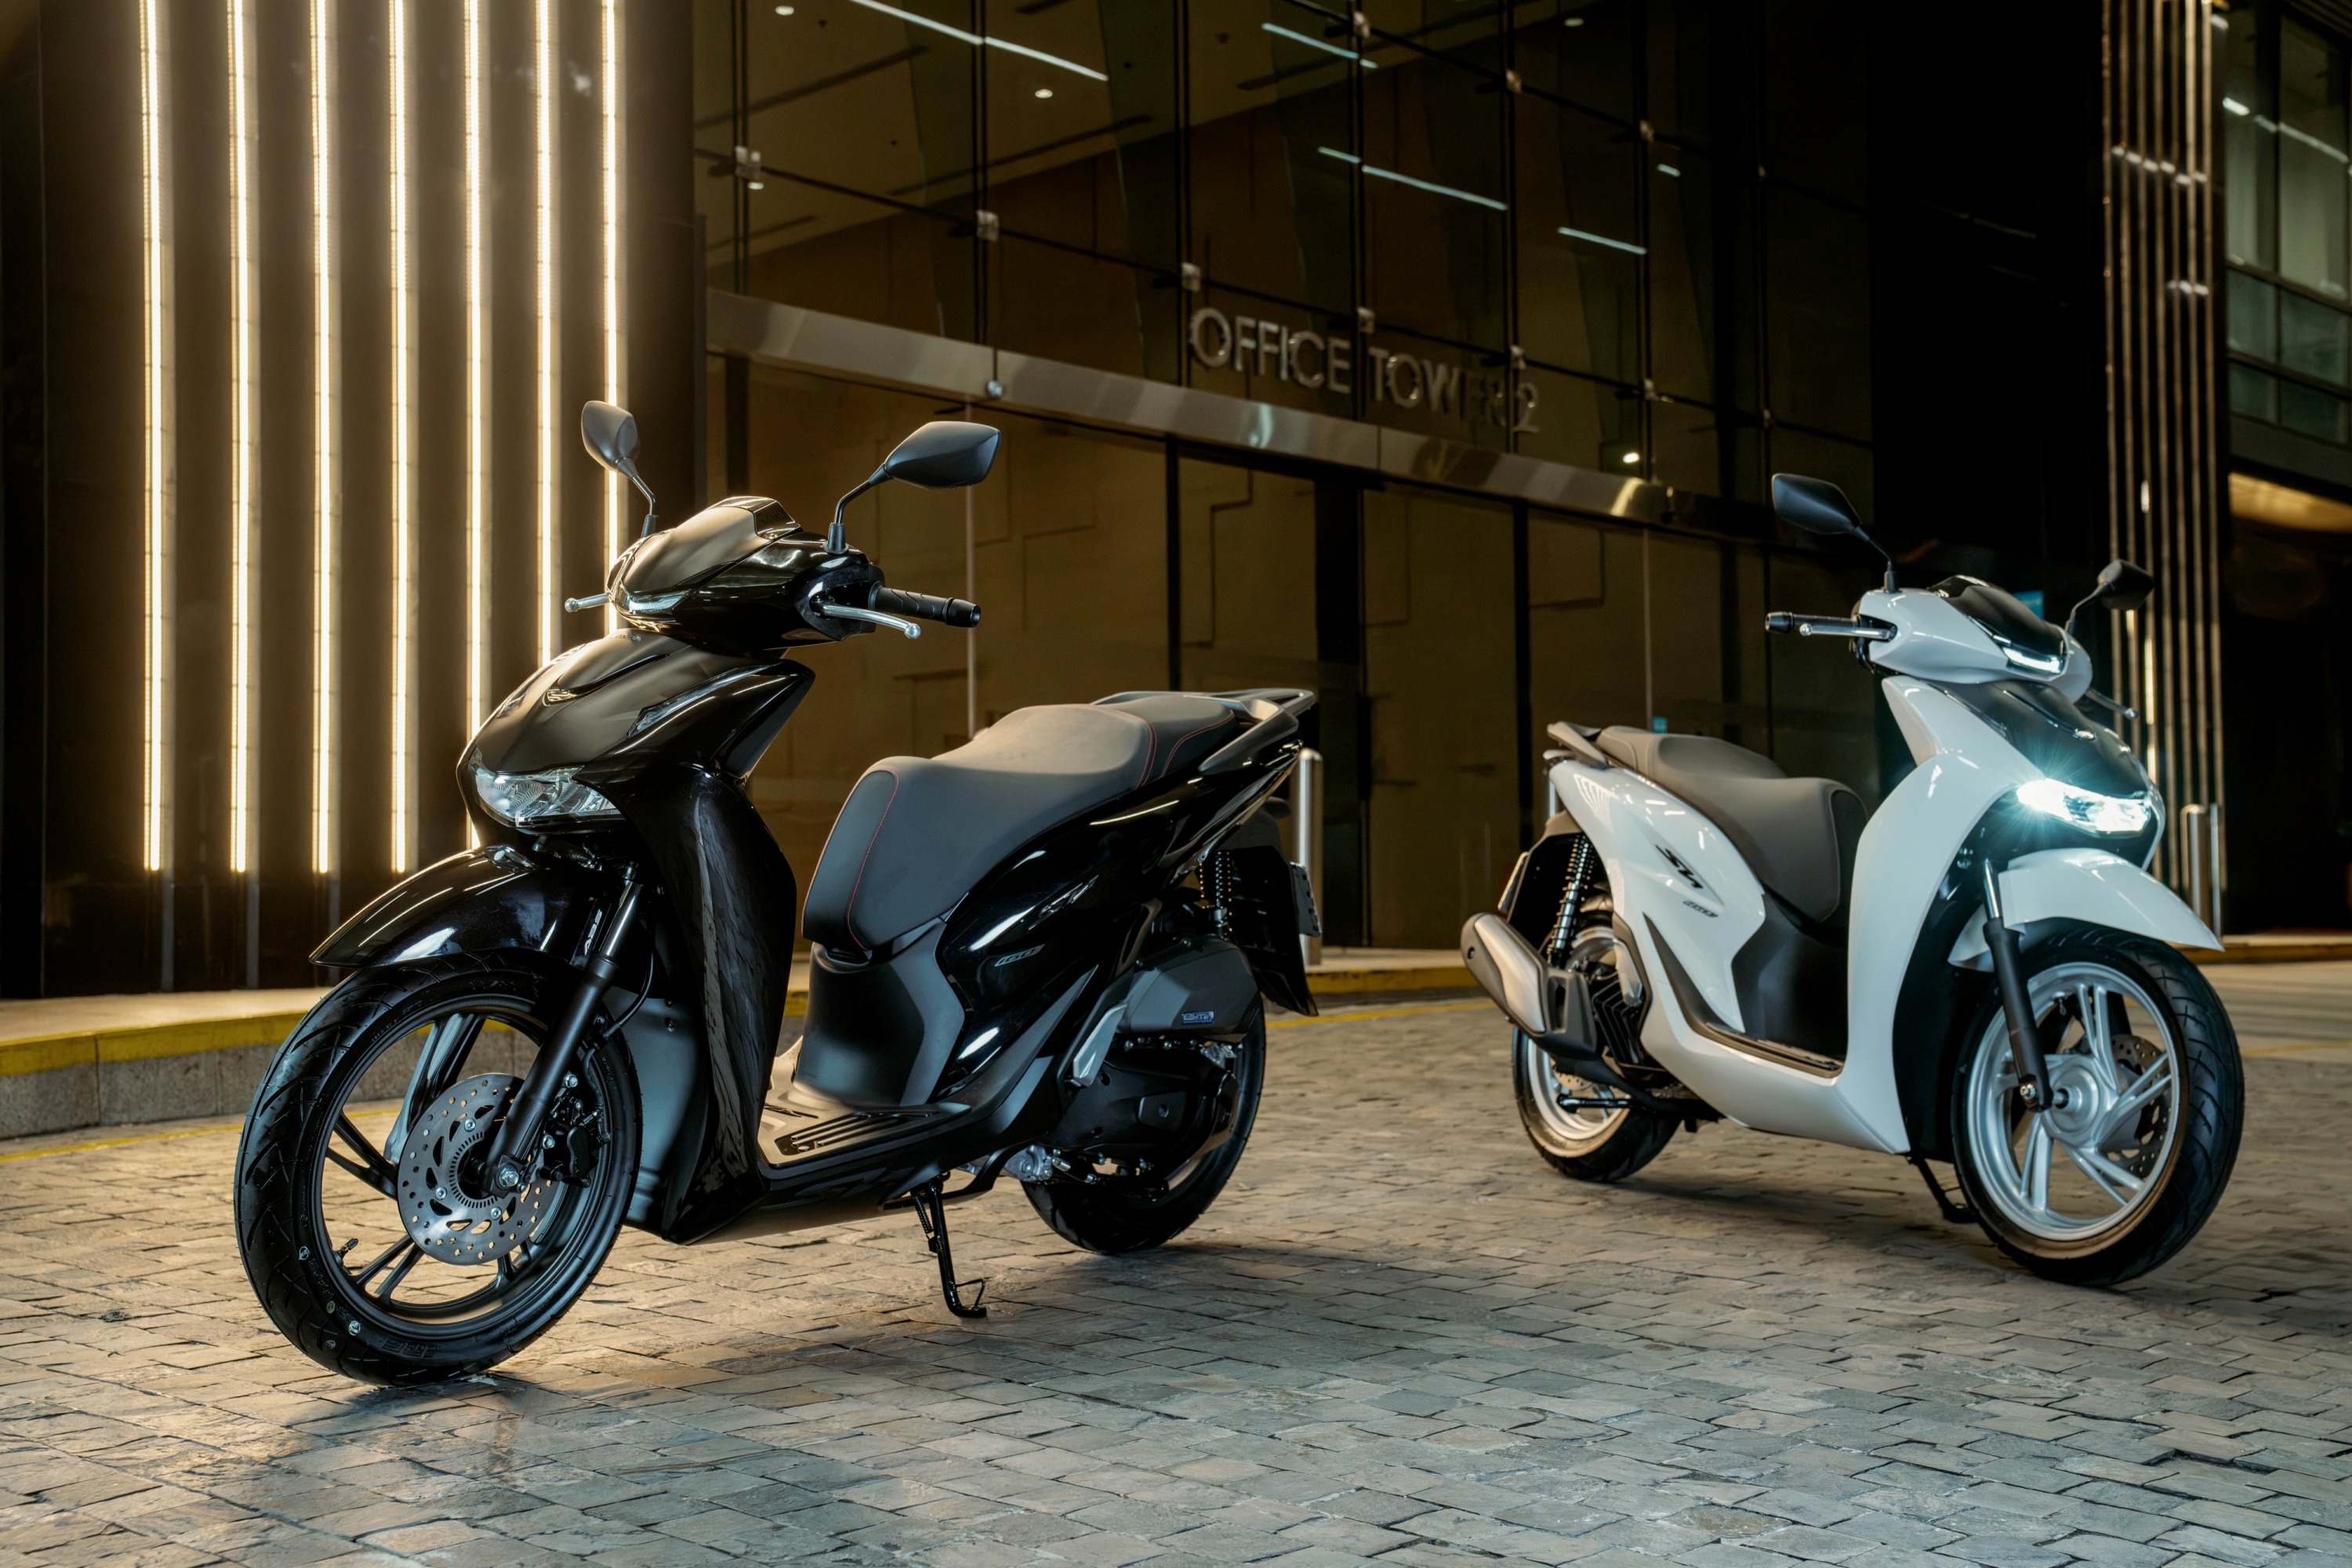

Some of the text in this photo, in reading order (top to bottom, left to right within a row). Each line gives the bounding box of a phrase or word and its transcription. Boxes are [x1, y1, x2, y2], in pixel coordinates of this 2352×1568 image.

[1189, 307, 1352, 394] OFFICE
[1512, 381, 1540, 434] 2
[584, 908, 603, 956] ABS
